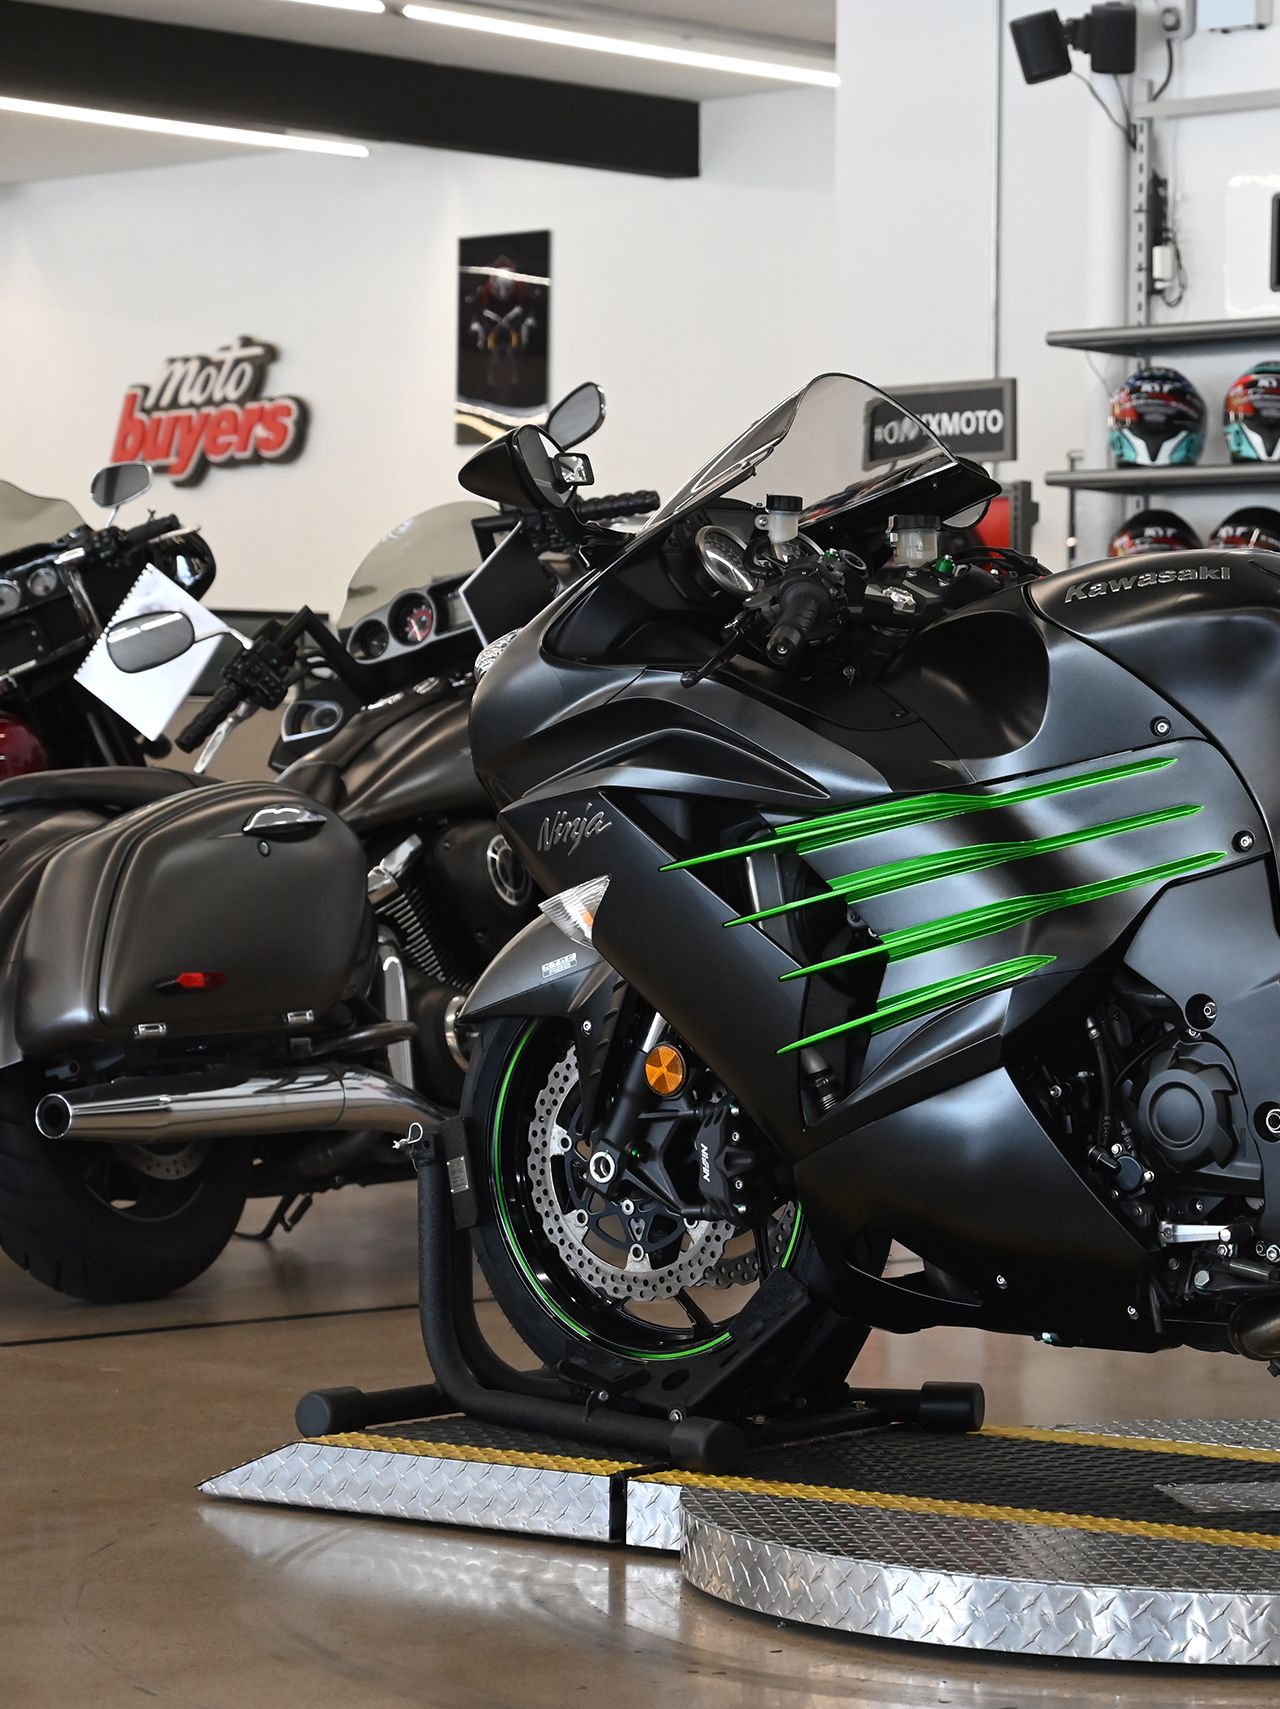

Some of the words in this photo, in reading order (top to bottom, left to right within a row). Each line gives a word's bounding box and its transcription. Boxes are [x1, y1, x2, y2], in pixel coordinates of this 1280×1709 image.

[110, 389, 297, 478] buyers
[1064, 566, 1231, 603] Kawasaki
[537, 803, 613, 857] Ninja
